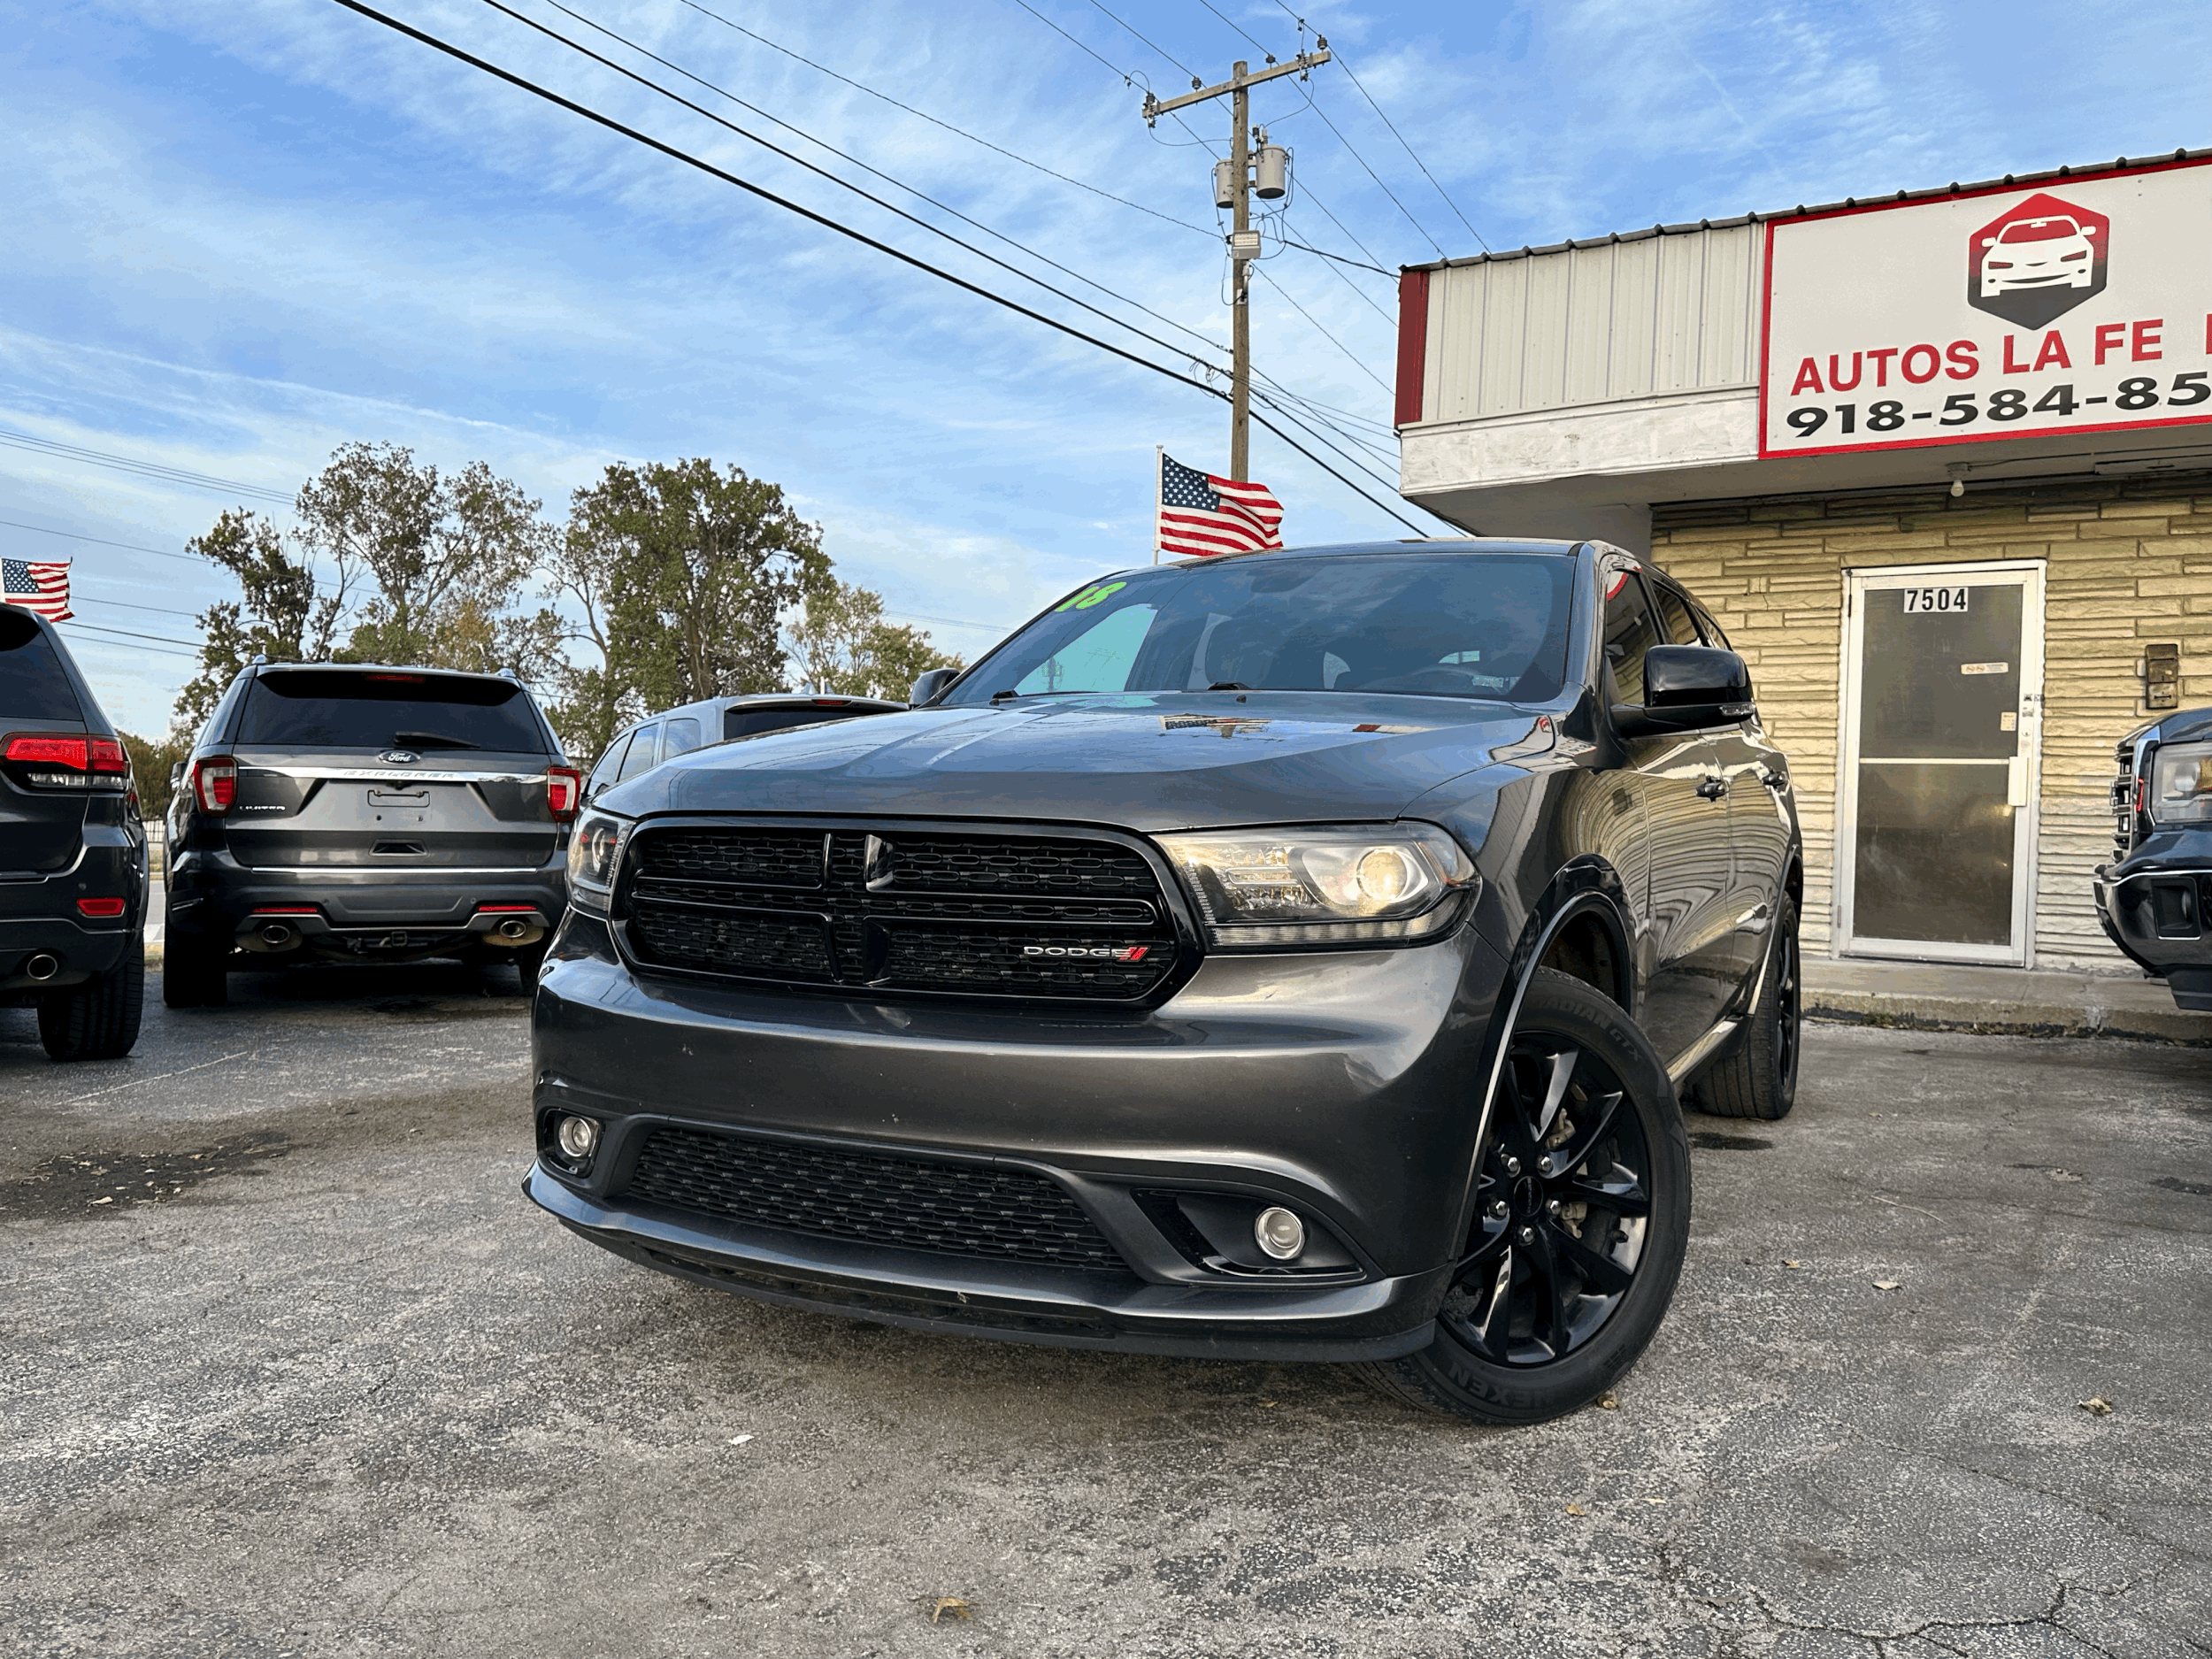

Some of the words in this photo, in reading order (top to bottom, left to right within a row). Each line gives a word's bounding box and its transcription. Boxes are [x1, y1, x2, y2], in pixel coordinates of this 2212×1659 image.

[1790, 340, 1980, 396] AUTOS
[2002, 329, 2072, 375] LA
[2094, 319, 2163, 365] FE
[1786, 371, 2211, 438] 918-584-85
[1054, 581, 1127, 612] 18
[1907, 588, 1966, 611] 7504
[388, 752, 411, 762] Ford
[343, 770, 455, 780] EXPLORER
[1023, 946, 1131, 958] DODGE
[1609, 1028, 1645, 1063] GTX
[1447, 1362, 1553, 1409] NEXEN
